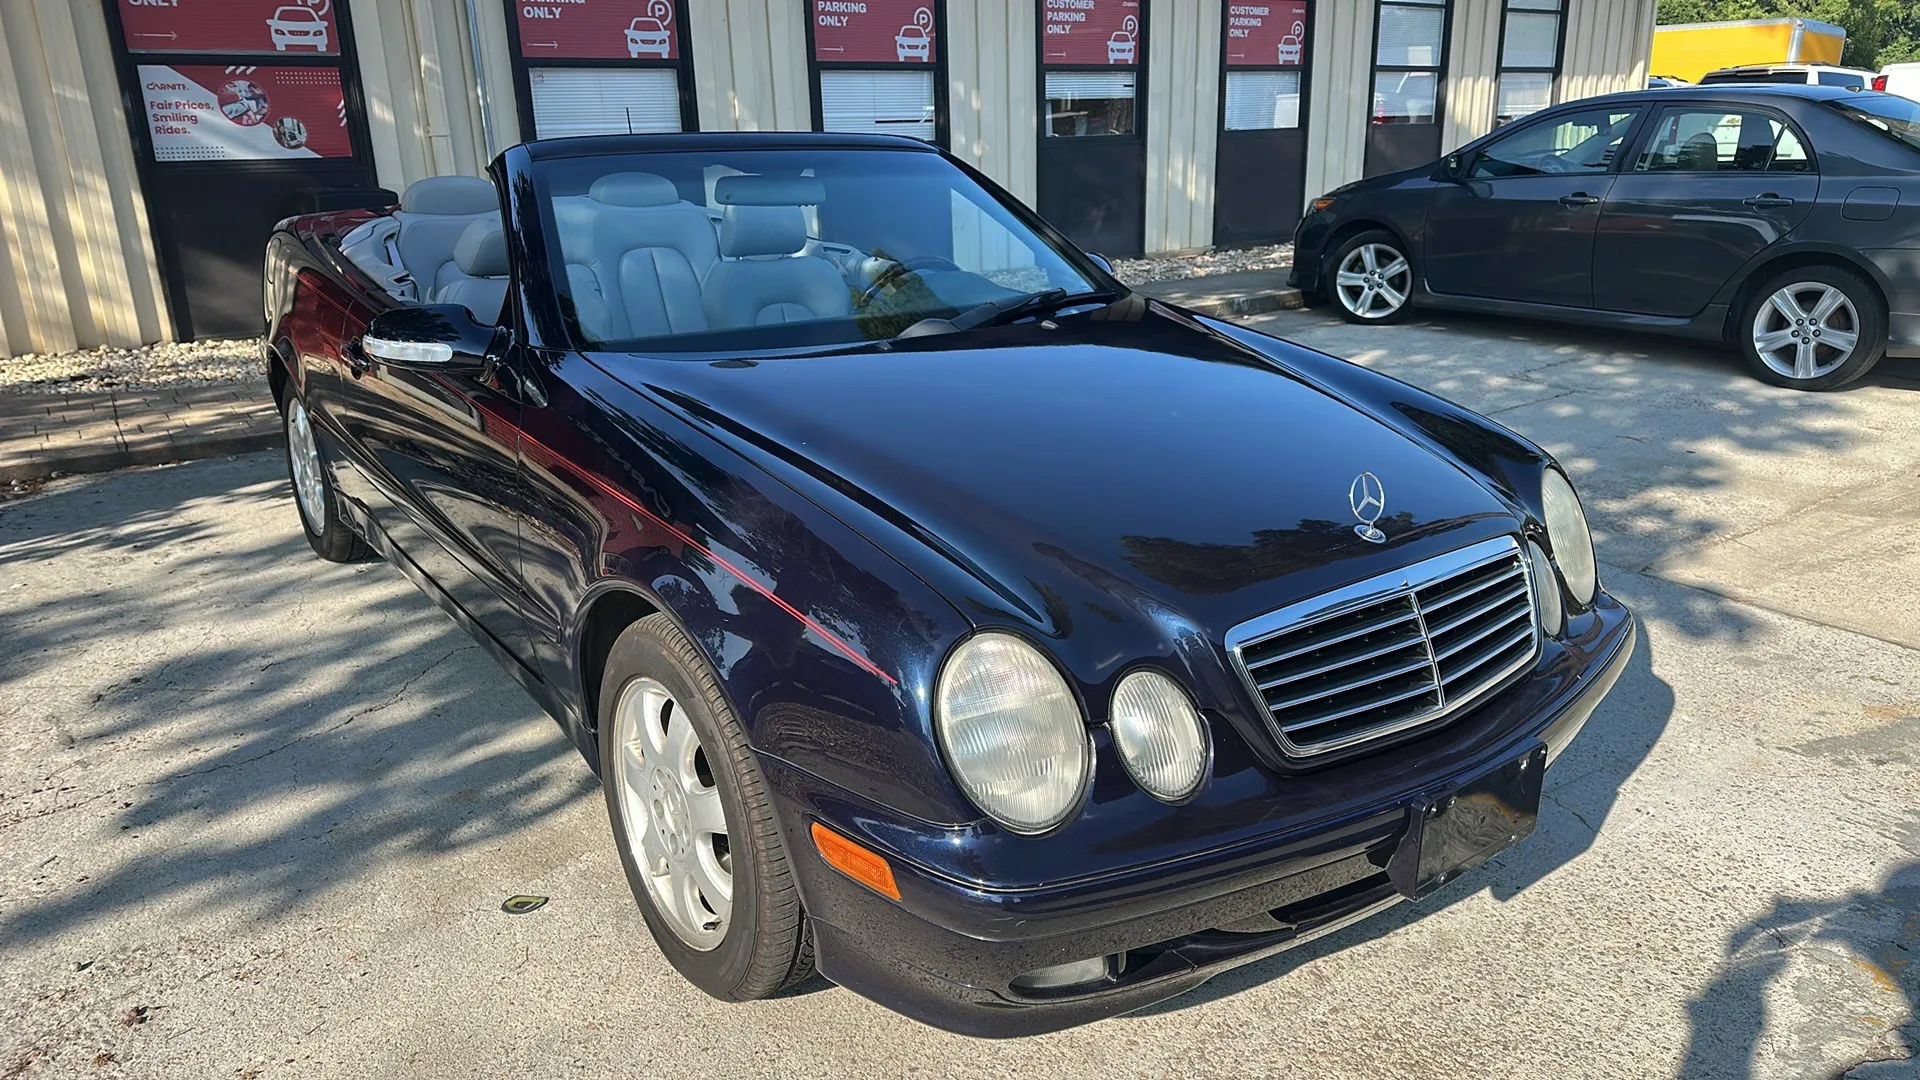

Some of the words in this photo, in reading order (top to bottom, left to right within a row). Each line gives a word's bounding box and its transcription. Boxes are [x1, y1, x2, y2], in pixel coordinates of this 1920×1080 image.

[818, 0, 867, 13] PARKING
[1046, 0, 1095, 9] CUSTOMER
[523, 6, 562, 19] ONLY
[1230, 6, 1270, 16] CUSTOMER
[818, 15, 849, 27] ONLY
[1046, 11, 1087, 22] PARKING
[1229, 17, 1262, 27] PARKING
[1046, 24, 1072, 34] ONLY
[1229, 28, 1250, 38] ONLY
[150, 100, 172, 110] Fair
[175, 100, 215, 111] Prices,
[152, 112, 198, 125] Smiling
[155, 125, 191, 135] Rides.
